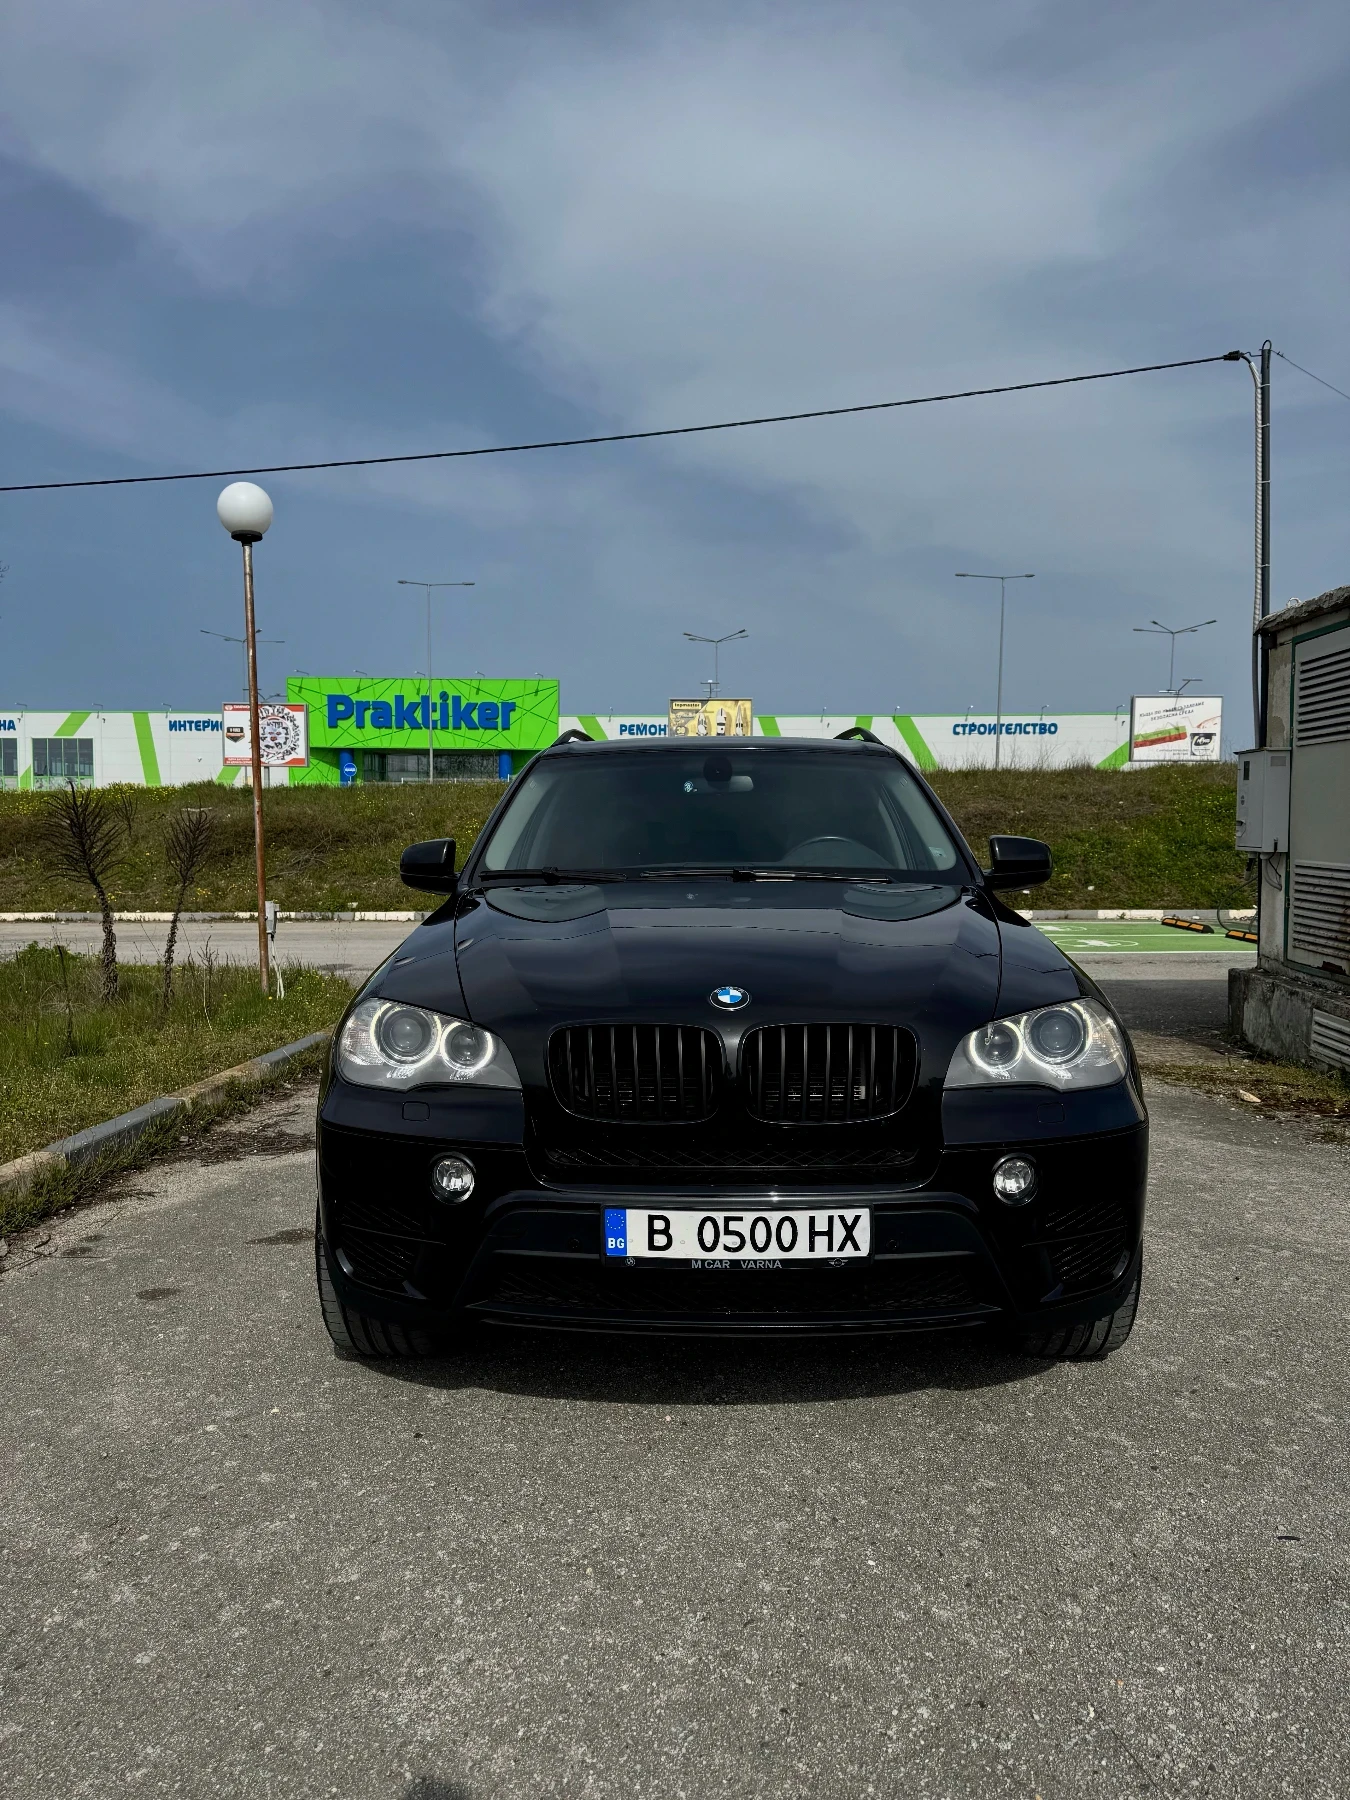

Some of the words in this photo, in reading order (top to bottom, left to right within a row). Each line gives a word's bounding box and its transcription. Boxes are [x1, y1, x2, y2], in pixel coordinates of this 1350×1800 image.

[327, 691, 516, 730] Praktiker
[619, 723, 668, 736] РЕМОН
[952, 722, 1058, 736] СТРОИТЕЛСТВО
[647, 1214, 673, 1252] B
[697, 1215, 798, 1253] 0500
[808, 1214, 862, 1253] HX
[607, 1238, 625, 1249] BG
[691, 1260, 702, 1269] M
[704, 1260, 730, 1269] CAR
[741, 1260, 782, 1269] VARNA
